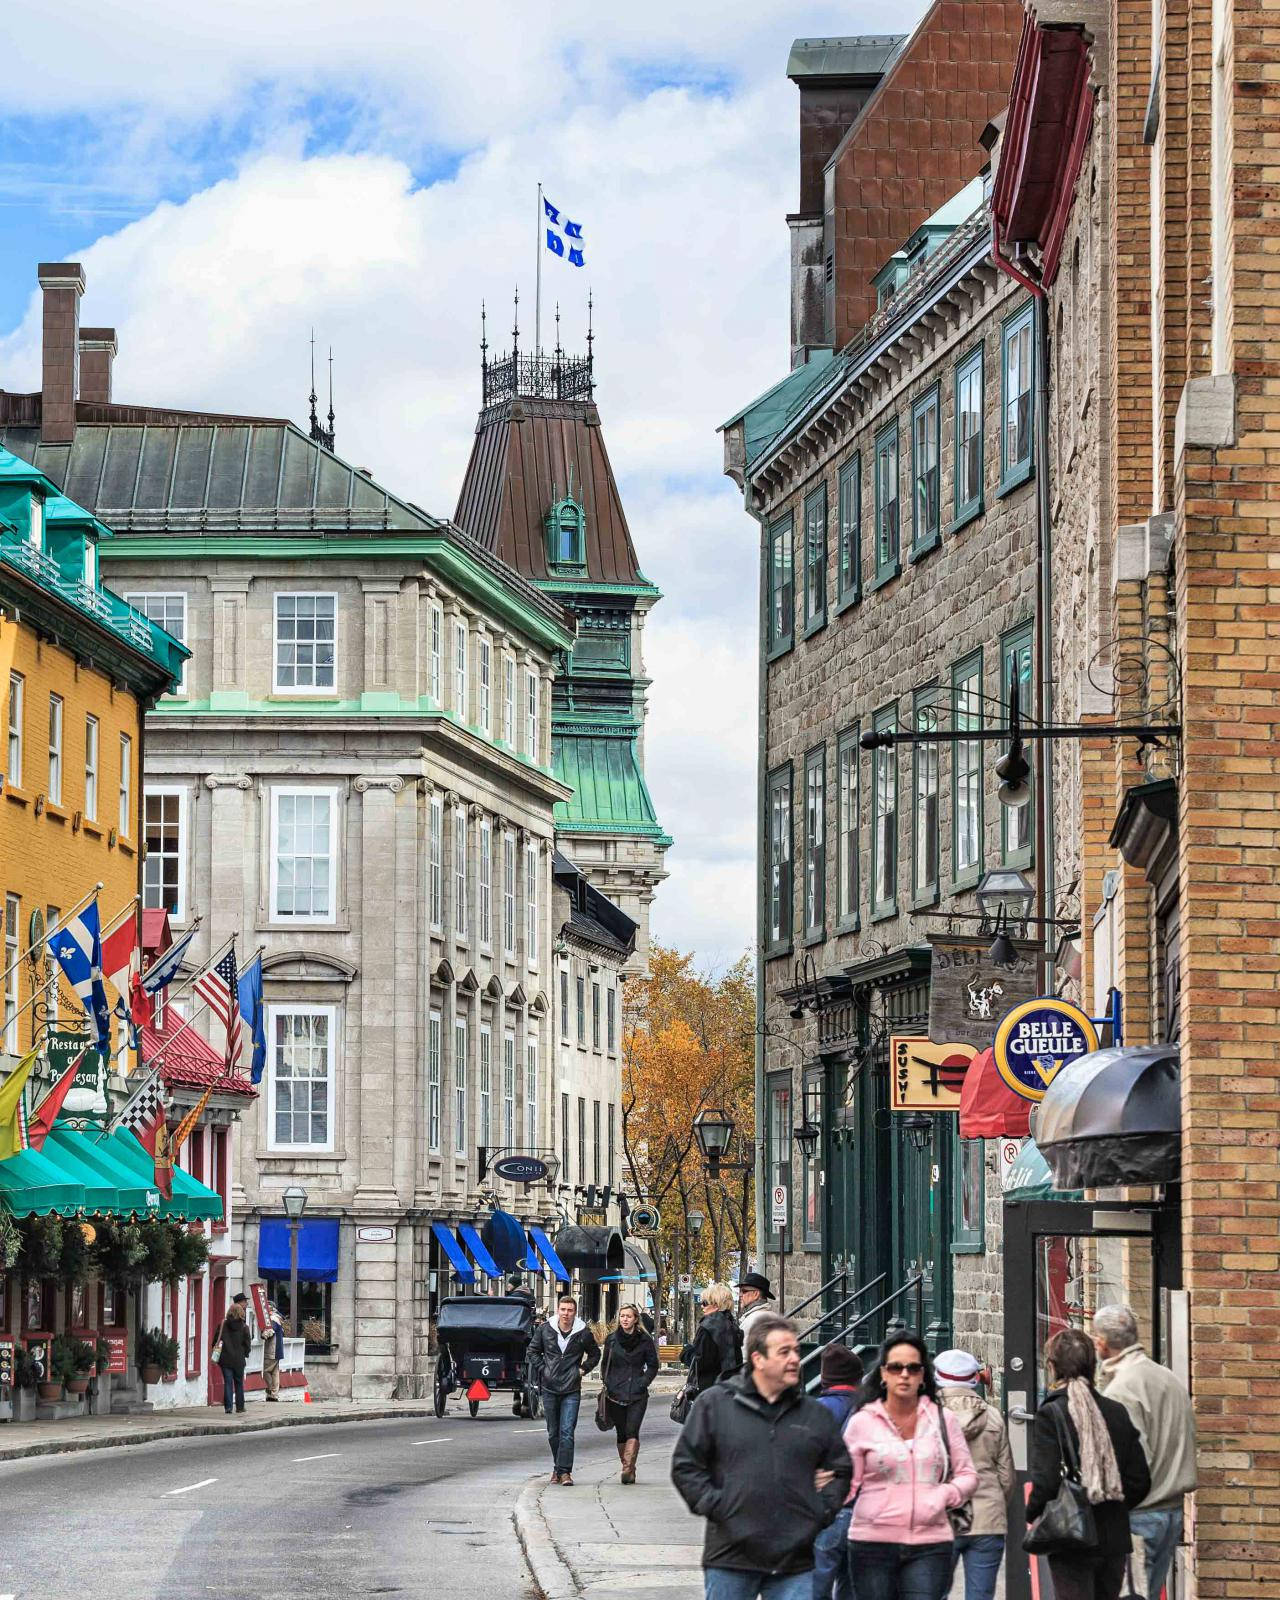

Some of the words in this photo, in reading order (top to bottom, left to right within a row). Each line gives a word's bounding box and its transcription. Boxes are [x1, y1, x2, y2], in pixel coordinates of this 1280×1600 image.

[1018, 1021, 1074, 1039] BELLE
[1010, 1037, 1084, 1055] GUEULE
[897, 1043, 908, 1104] SUSHI
[481, 1365, 490, 1376] 6
